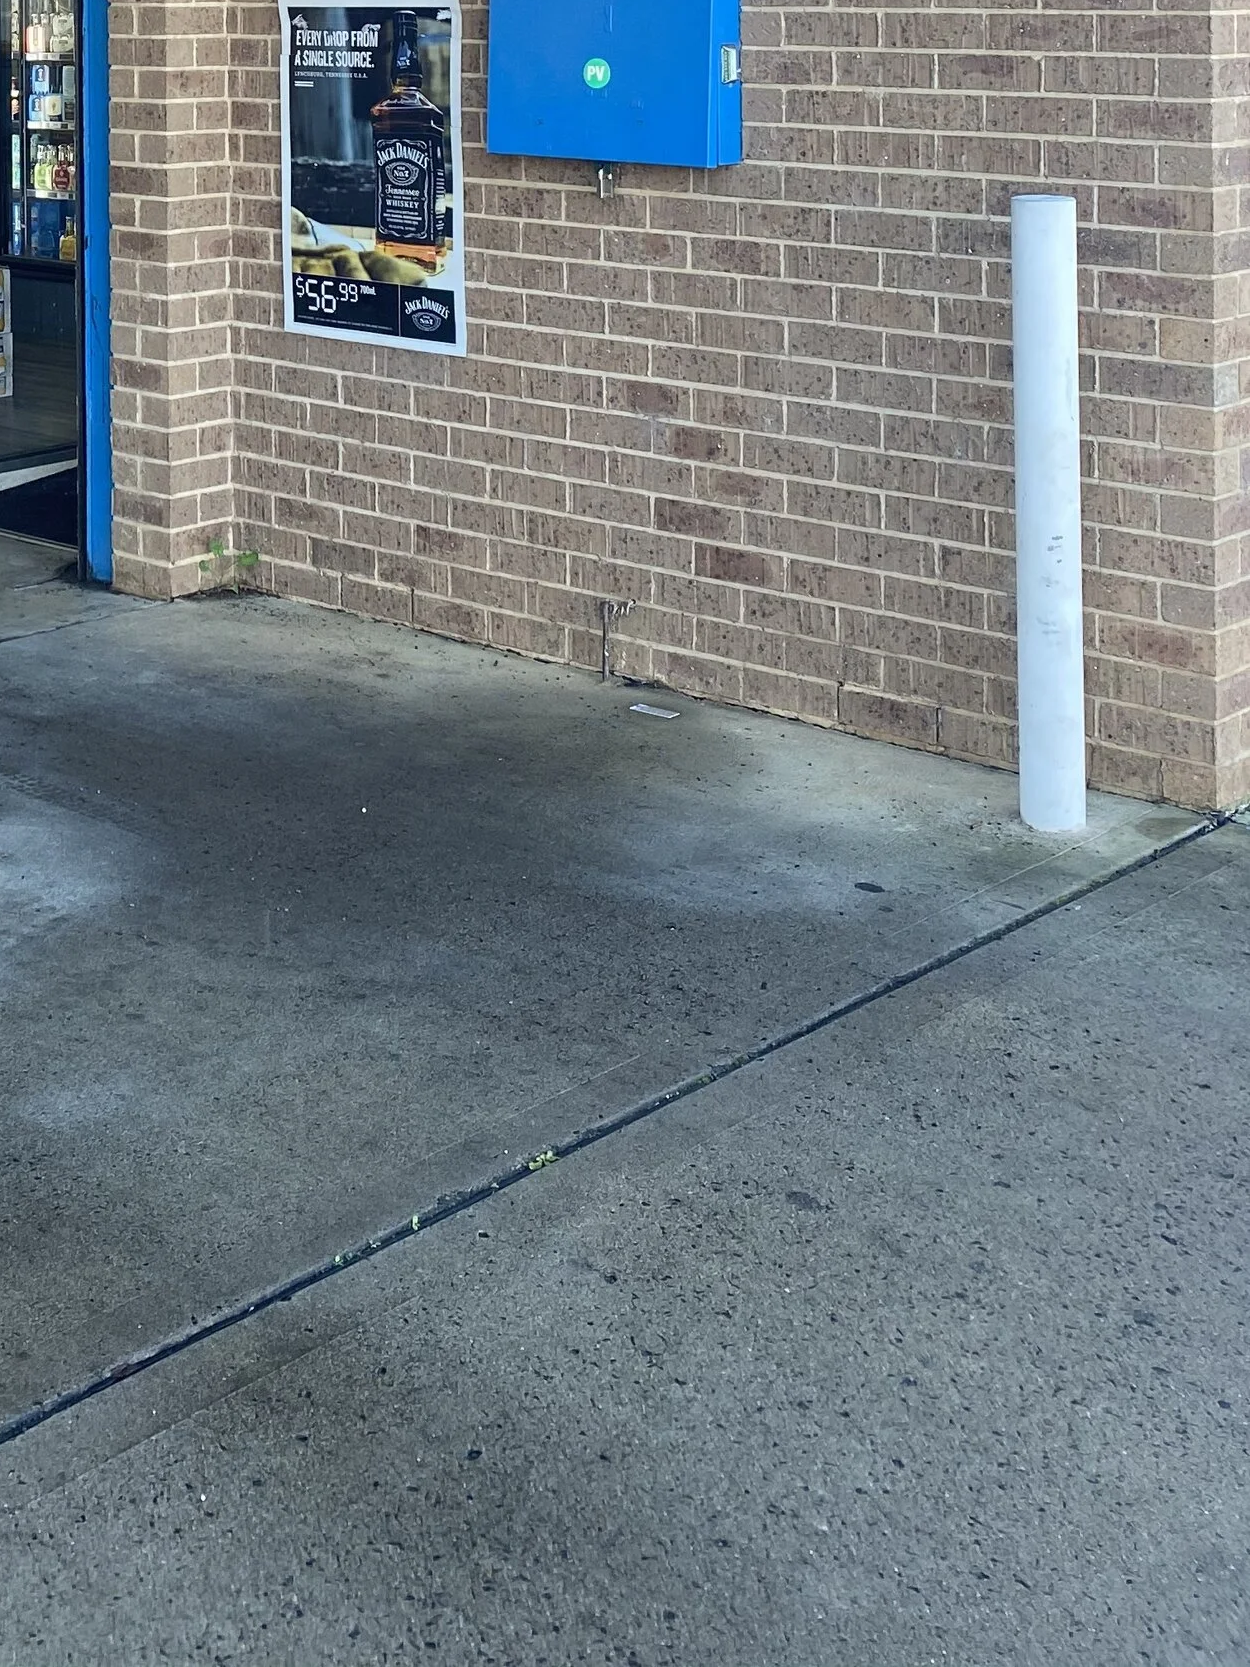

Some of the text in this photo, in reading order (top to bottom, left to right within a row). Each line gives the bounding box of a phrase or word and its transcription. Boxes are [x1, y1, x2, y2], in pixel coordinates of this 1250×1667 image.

[296, 29, 379, 48] EVERY DROP FROM
[294, 50, 375, 68] A SINGLE SOURCE.
[586, 65, 606, 84] PV
[377, 142, 429, 169] JACK DANIEL'S
[386, 199, 419, 209] WHISKEY
[404, 296, 450, 320] JACK DANIEL'S
